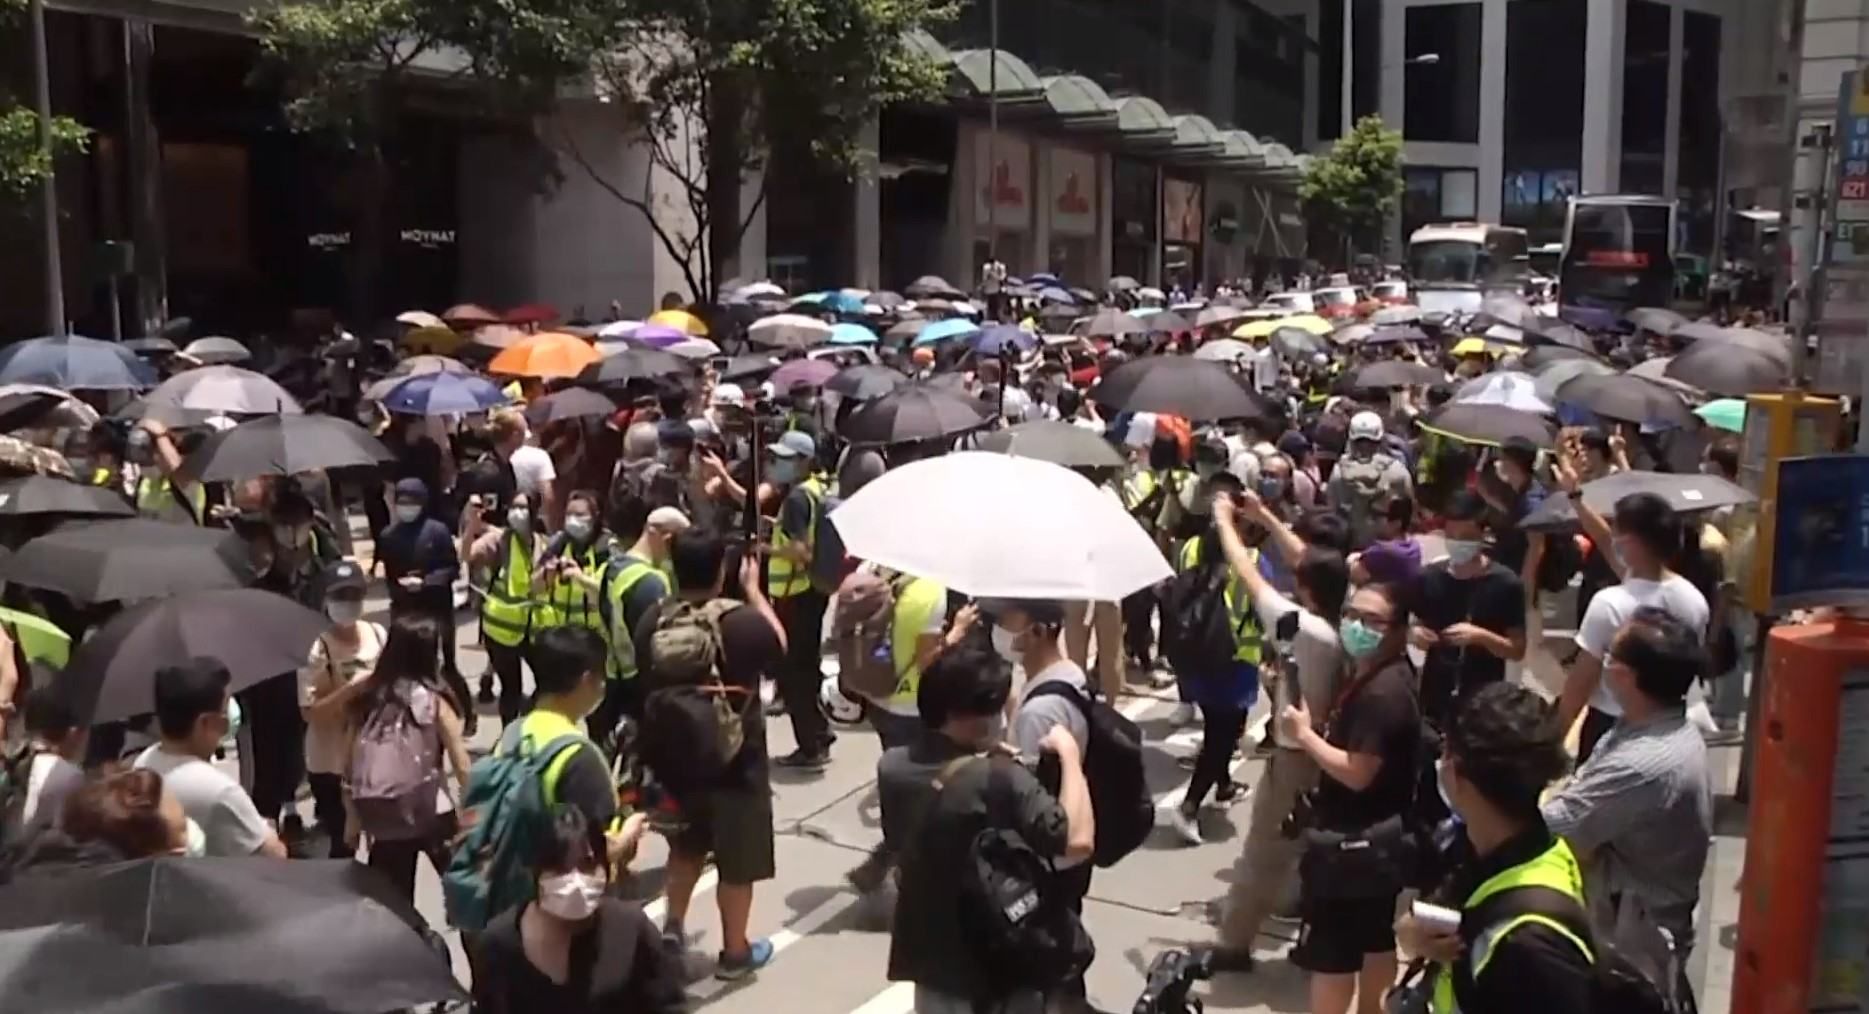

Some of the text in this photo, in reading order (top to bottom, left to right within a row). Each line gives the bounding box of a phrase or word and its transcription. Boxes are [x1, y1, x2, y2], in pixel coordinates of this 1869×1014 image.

[1842, 181, 1866, 197] 621
[308, 232, 350, 246] MOYNAT
[401, 229, 455, 242] MOYNAT
